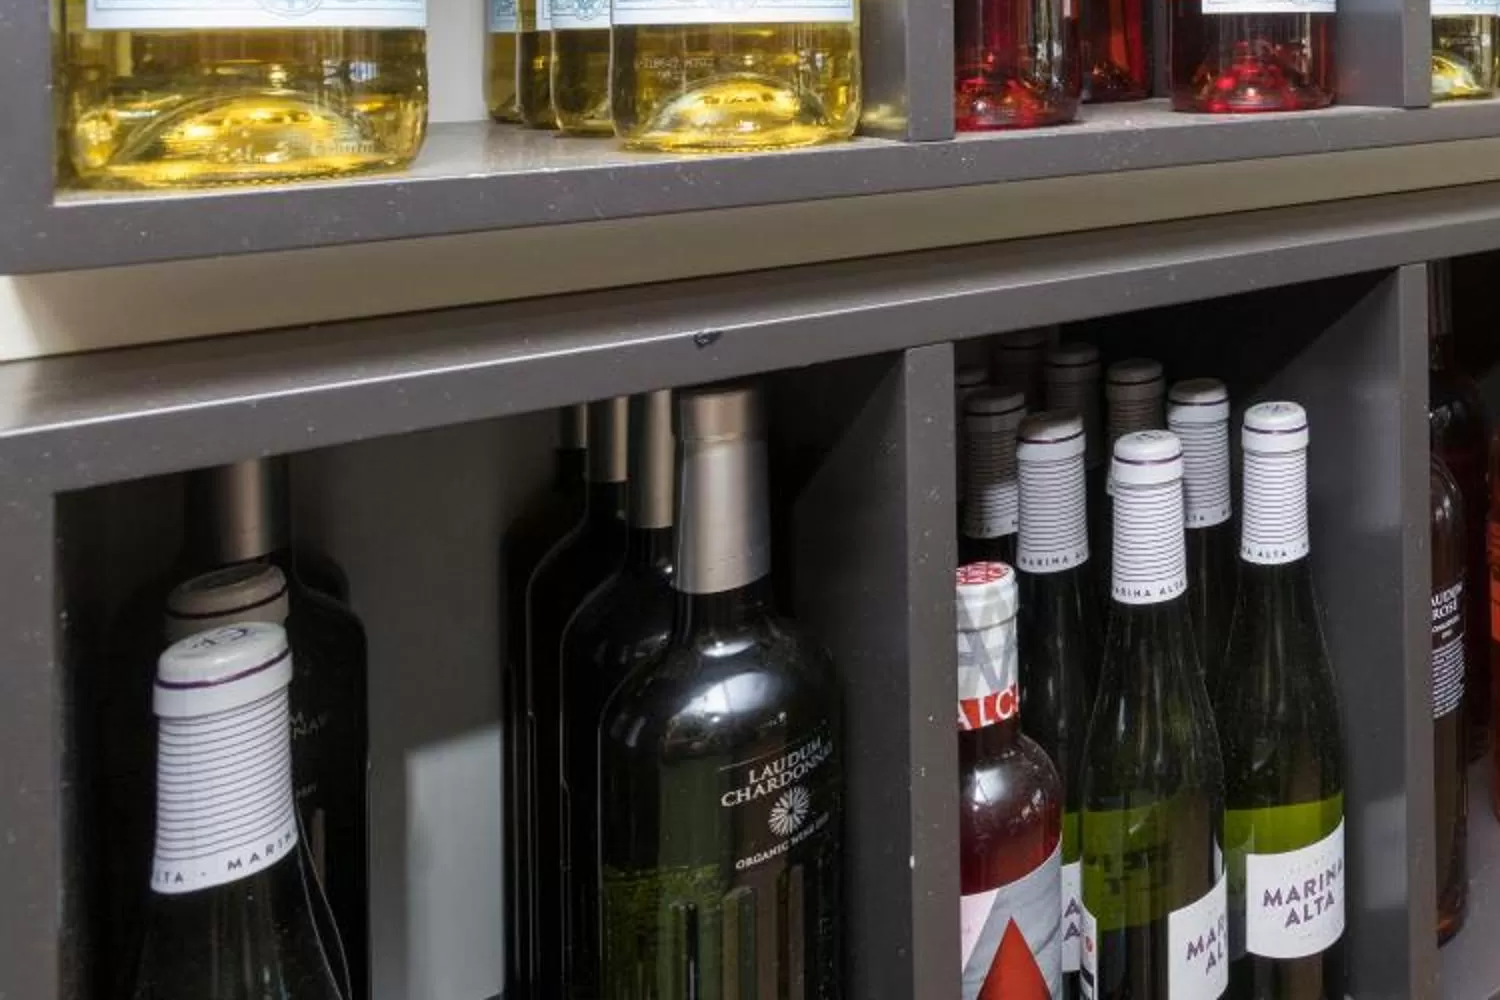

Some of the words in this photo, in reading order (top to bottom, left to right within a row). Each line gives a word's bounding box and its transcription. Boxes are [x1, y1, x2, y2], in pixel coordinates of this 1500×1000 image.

[749, 736, 821, 784] LAUDUM
[227, 832, 292, 871] MARIN
[735, 839, 790, 870] ORGANIC
[1285, 889, 1335, 929] ALTA
[1186, 914, 1225, 961] MAR
[1205, 942, 1224, 977] AL
